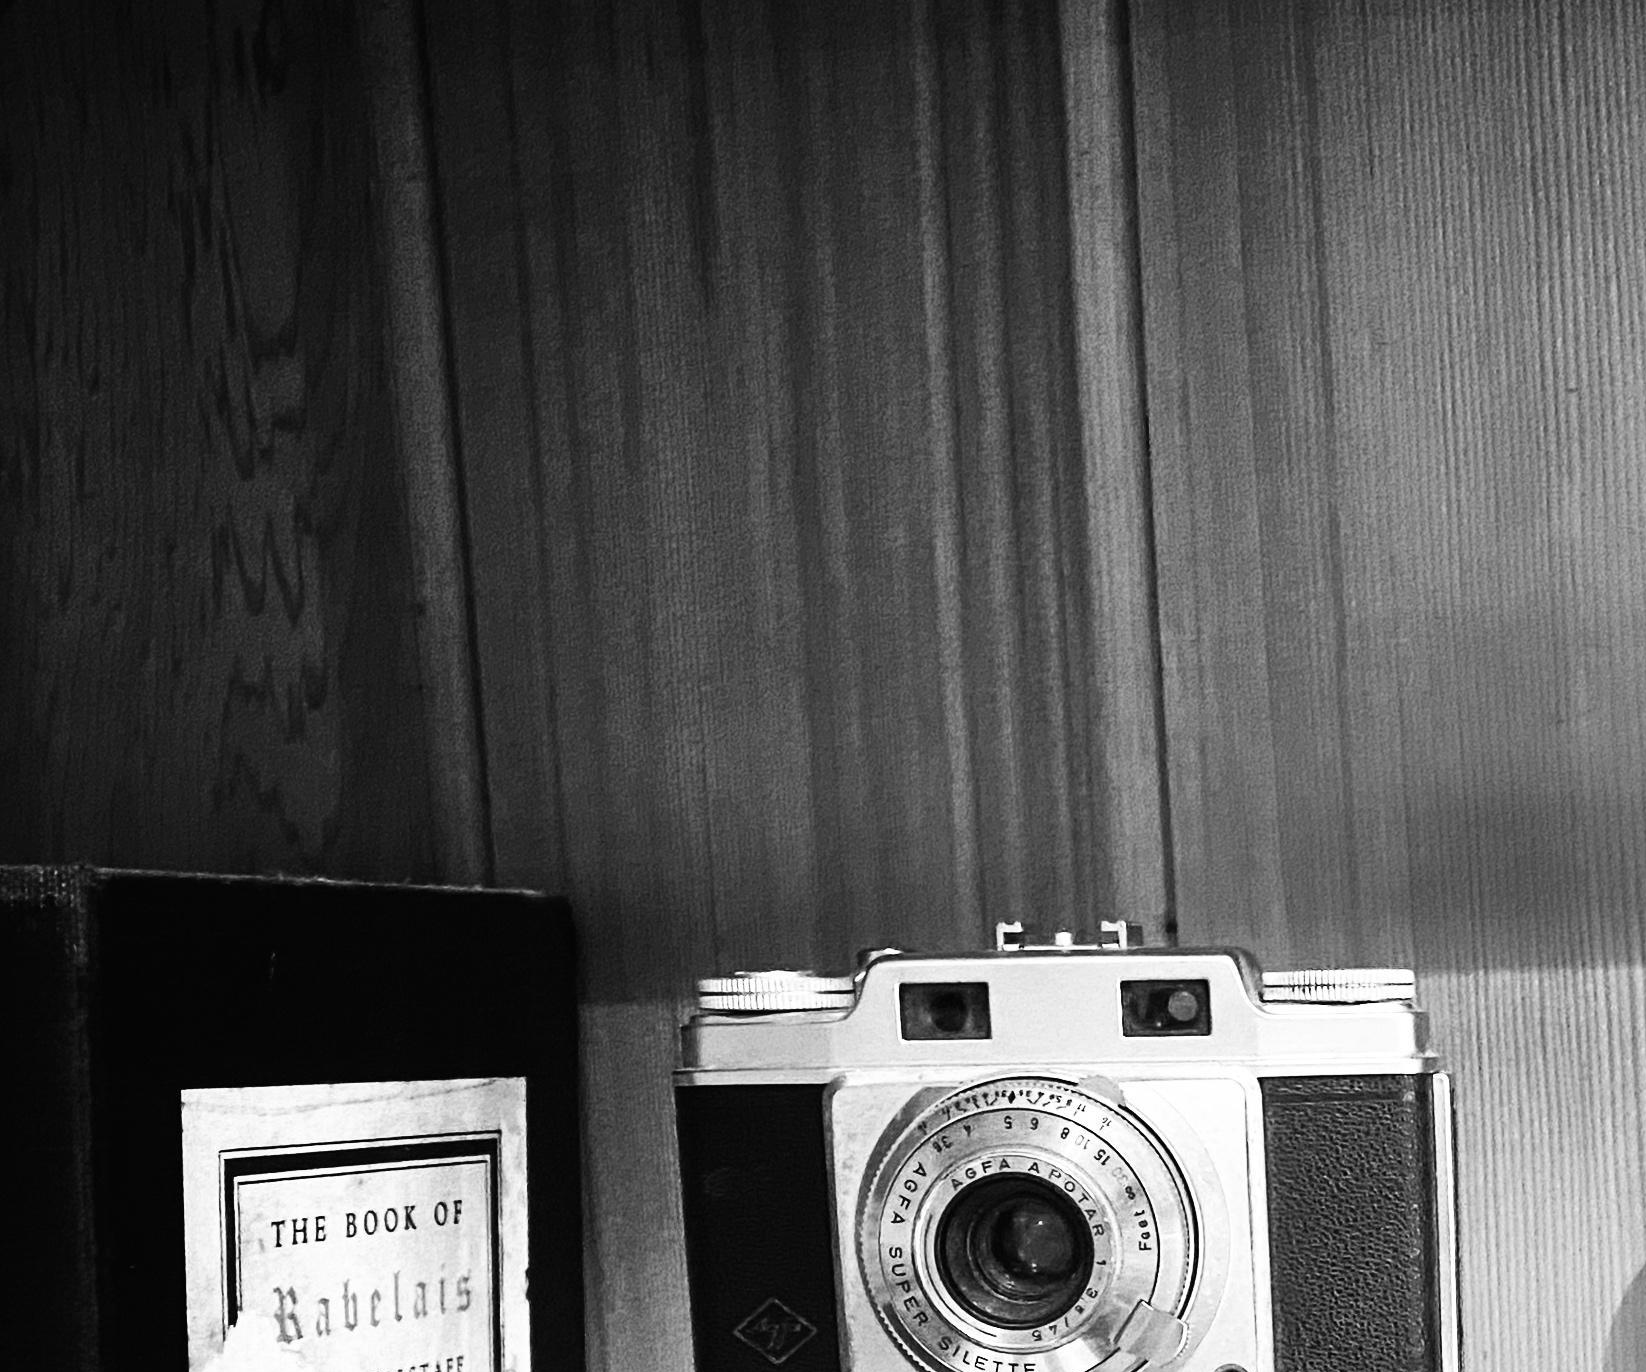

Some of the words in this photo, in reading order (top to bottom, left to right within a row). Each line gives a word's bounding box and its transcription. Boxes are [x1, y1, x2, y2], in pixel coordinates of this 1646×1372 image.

[962, 1124, 972, 1137] 4
[1003, 1115, 1013, 1130] 5
[1030, 1117, 1039, 1131] 6
[1060, 1127, 1070, 1140] 8
[1074, 1134, 1091, 1150] 10
[1093, 1148, 1111, 1166] 15
[890, 1161, 928, 1226] AGFA
[950, 1157, 1011, 1191] AGFA
[1027, 1160, 1106, 1238] APOTAR
[271, 1215, 327, 1249] THE
[345, 1204, 418, 1239] BOOK
[433, 1199, 463, 1226] OF
[1133, 1209, 1152, 1251] Feet
[888, 1246, 929, 1327] SUPER
[273, 1267, 472, 1346] Rabelais
